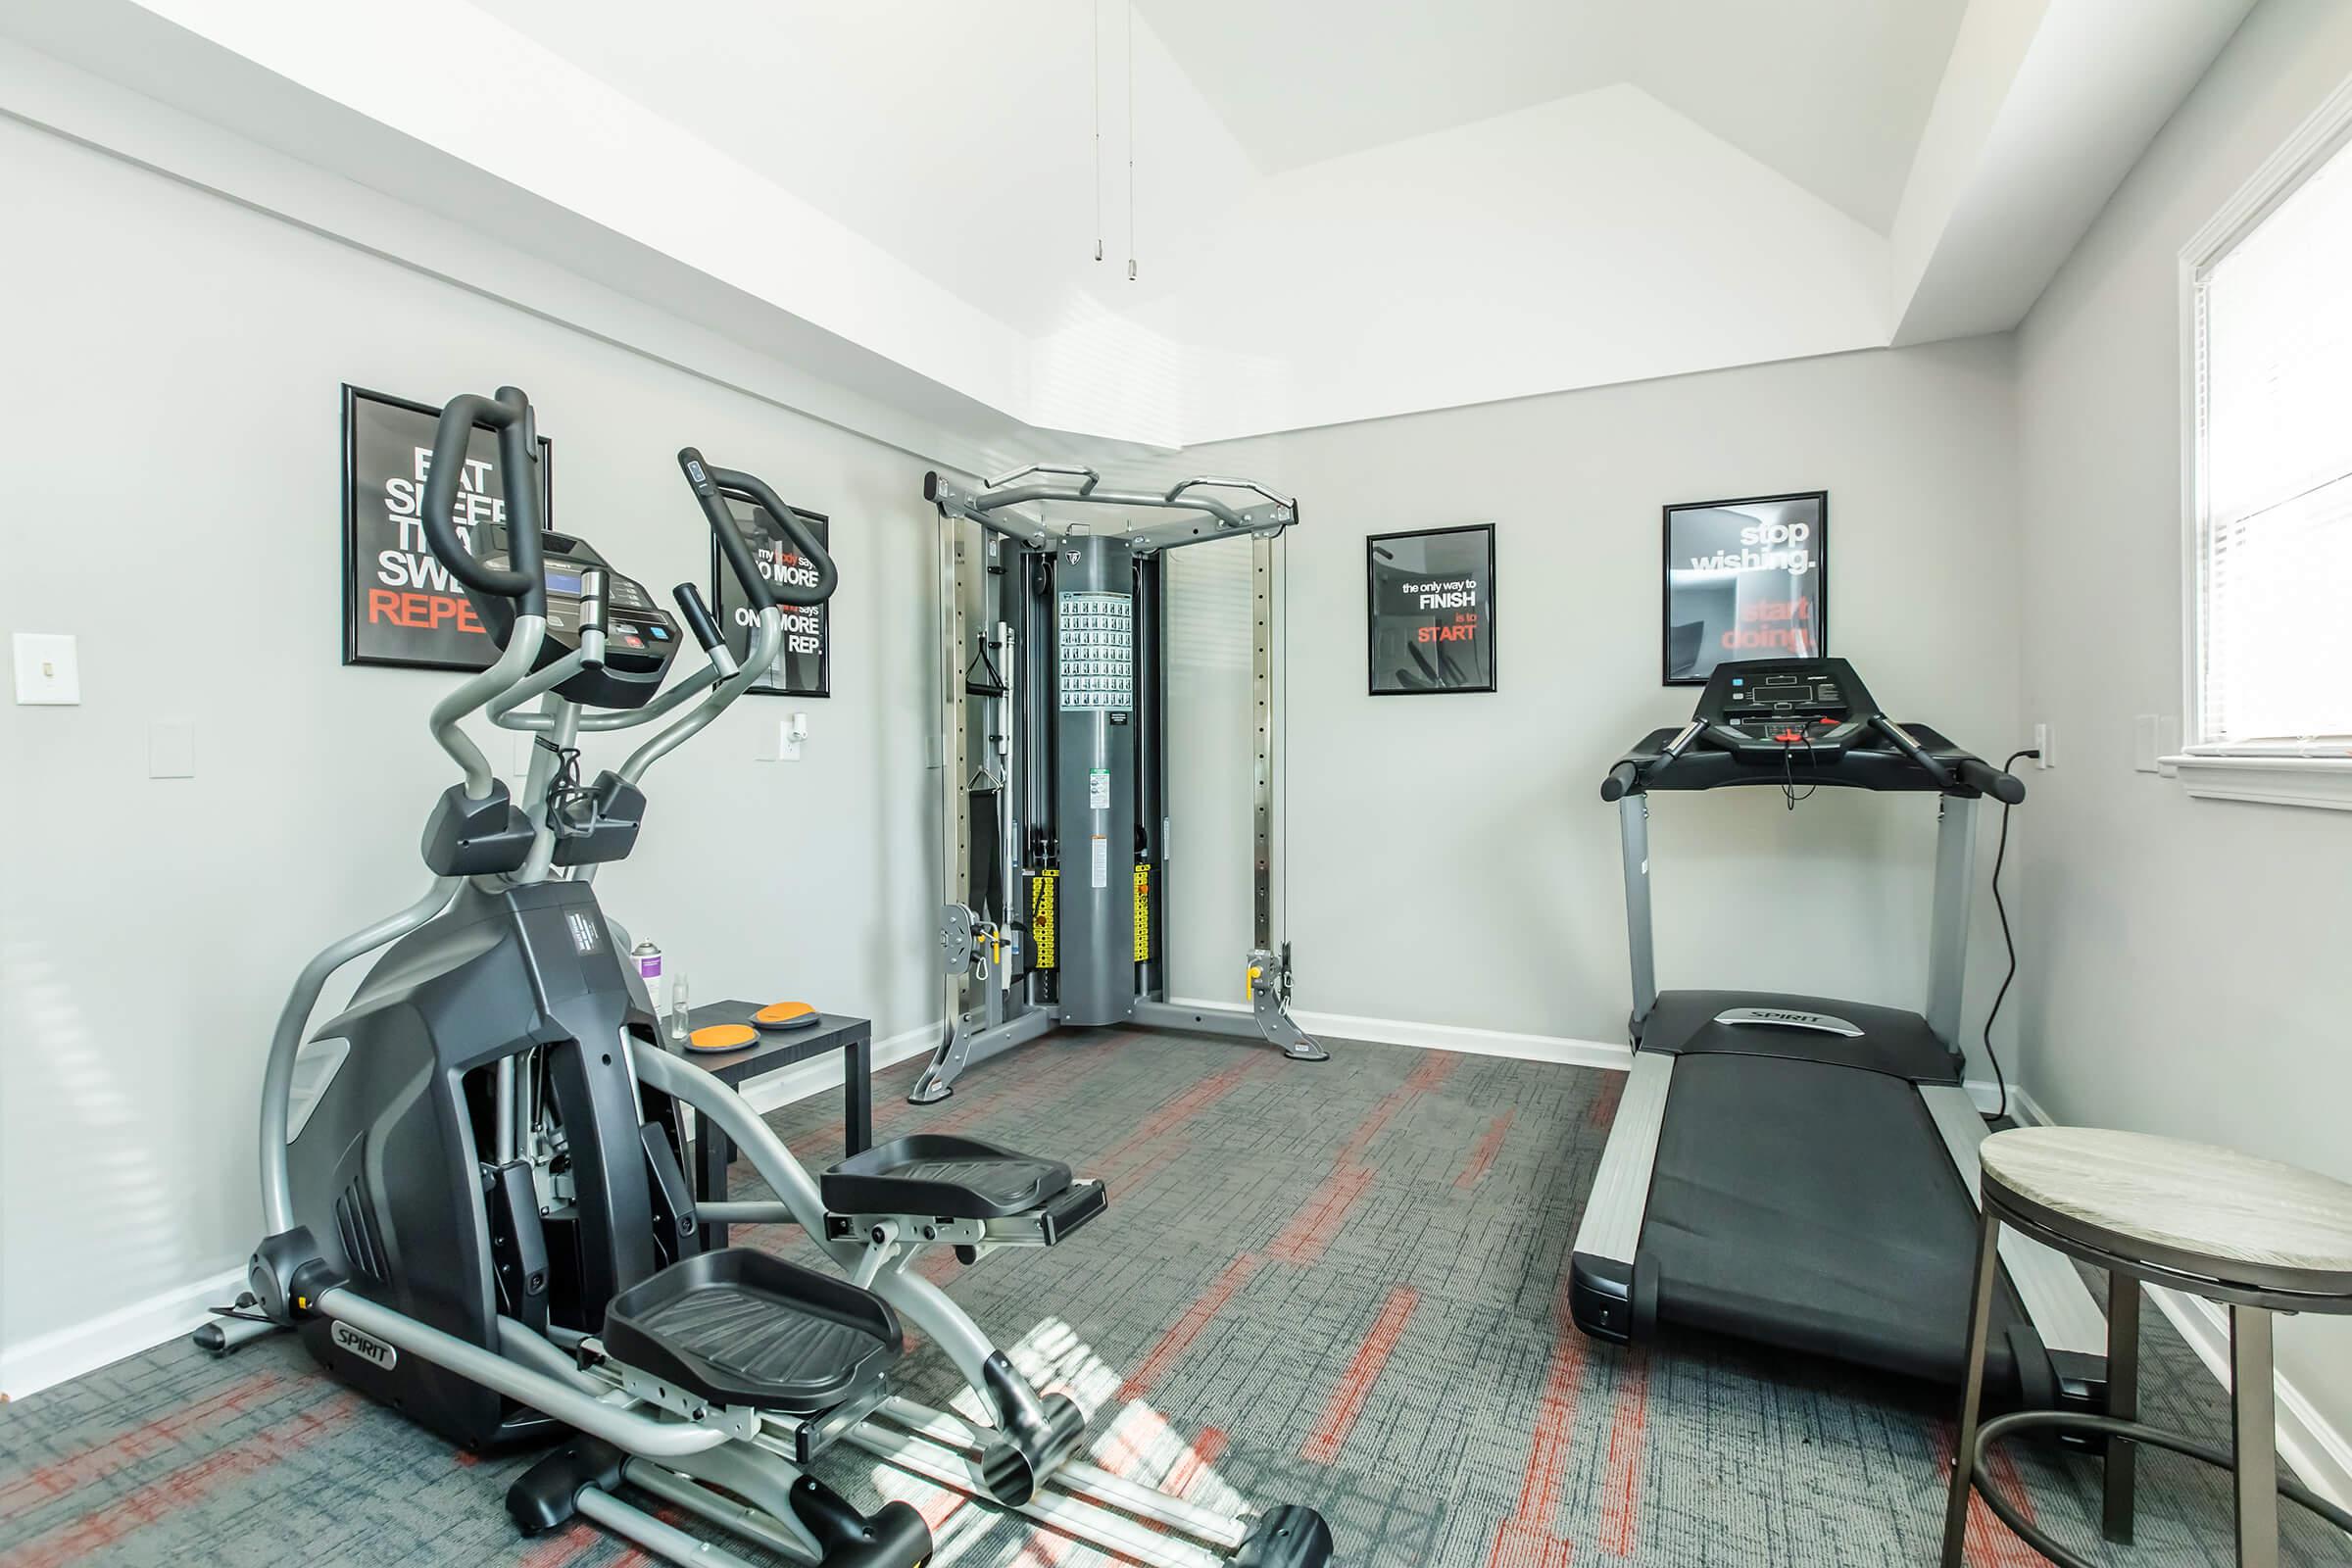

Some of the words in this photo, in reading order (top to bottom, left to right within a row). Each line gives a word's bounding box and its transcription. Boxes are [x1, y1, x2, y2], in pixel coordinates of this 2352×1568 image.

[1740, 522, 1809, 548] stop
[759, 549, 773, 562] my
[1690, 547, 1816, 575] wishing.
[774, 564, 818, 587] MORE
[1402, 583, 1419, 593] the
[1420, 581, 1442, 593] only
[1444, 580, 1464, 592] way
[1465, 579, 1477, 589] to
[1420, 591, 1476, 610] FINISH
[1742, 596, 1809, 621] start
[1455, 612, 1465, 622] is
[1466, 612, 1477, 622] to
[1418, 624, 1477, 643] START
[1748, 1010, 1824, 1023] SPIRIT
[337, 1329, 388, 1361] SPIRIT
